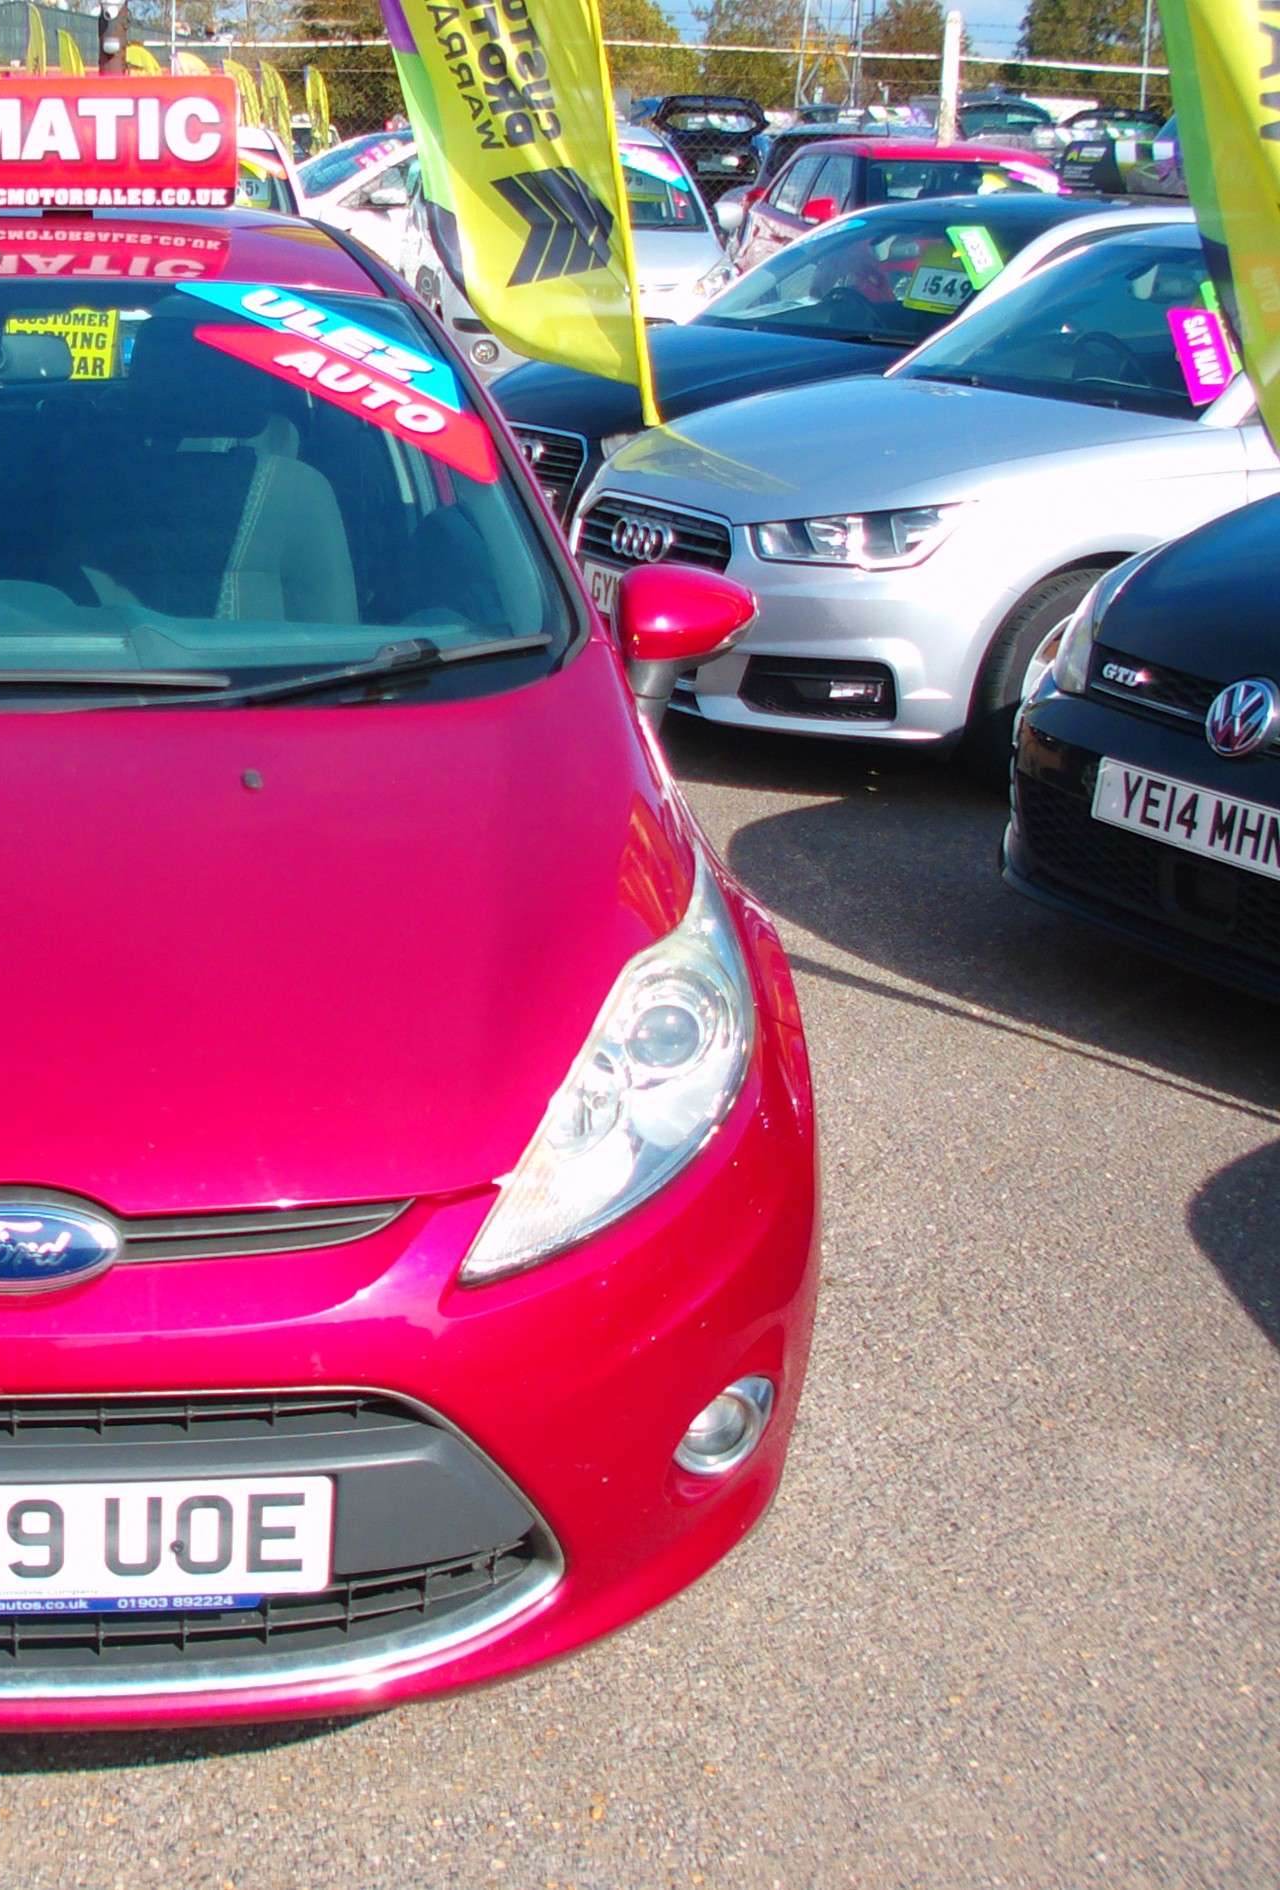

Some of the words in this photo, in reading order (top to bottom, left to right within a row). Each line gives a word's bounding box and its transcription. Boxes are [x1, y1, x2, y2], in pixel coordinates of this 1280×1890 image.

[240, 288, 434, 383] ULEZ
[272, 350, 446, 434] AUTO
[1123, 770, 1200, 840] YE14
[104, 1491, 307, 1578] UOE
[116, 1597, 168, 1609] 01903
[172, 1595, 234, 1608] 892224
